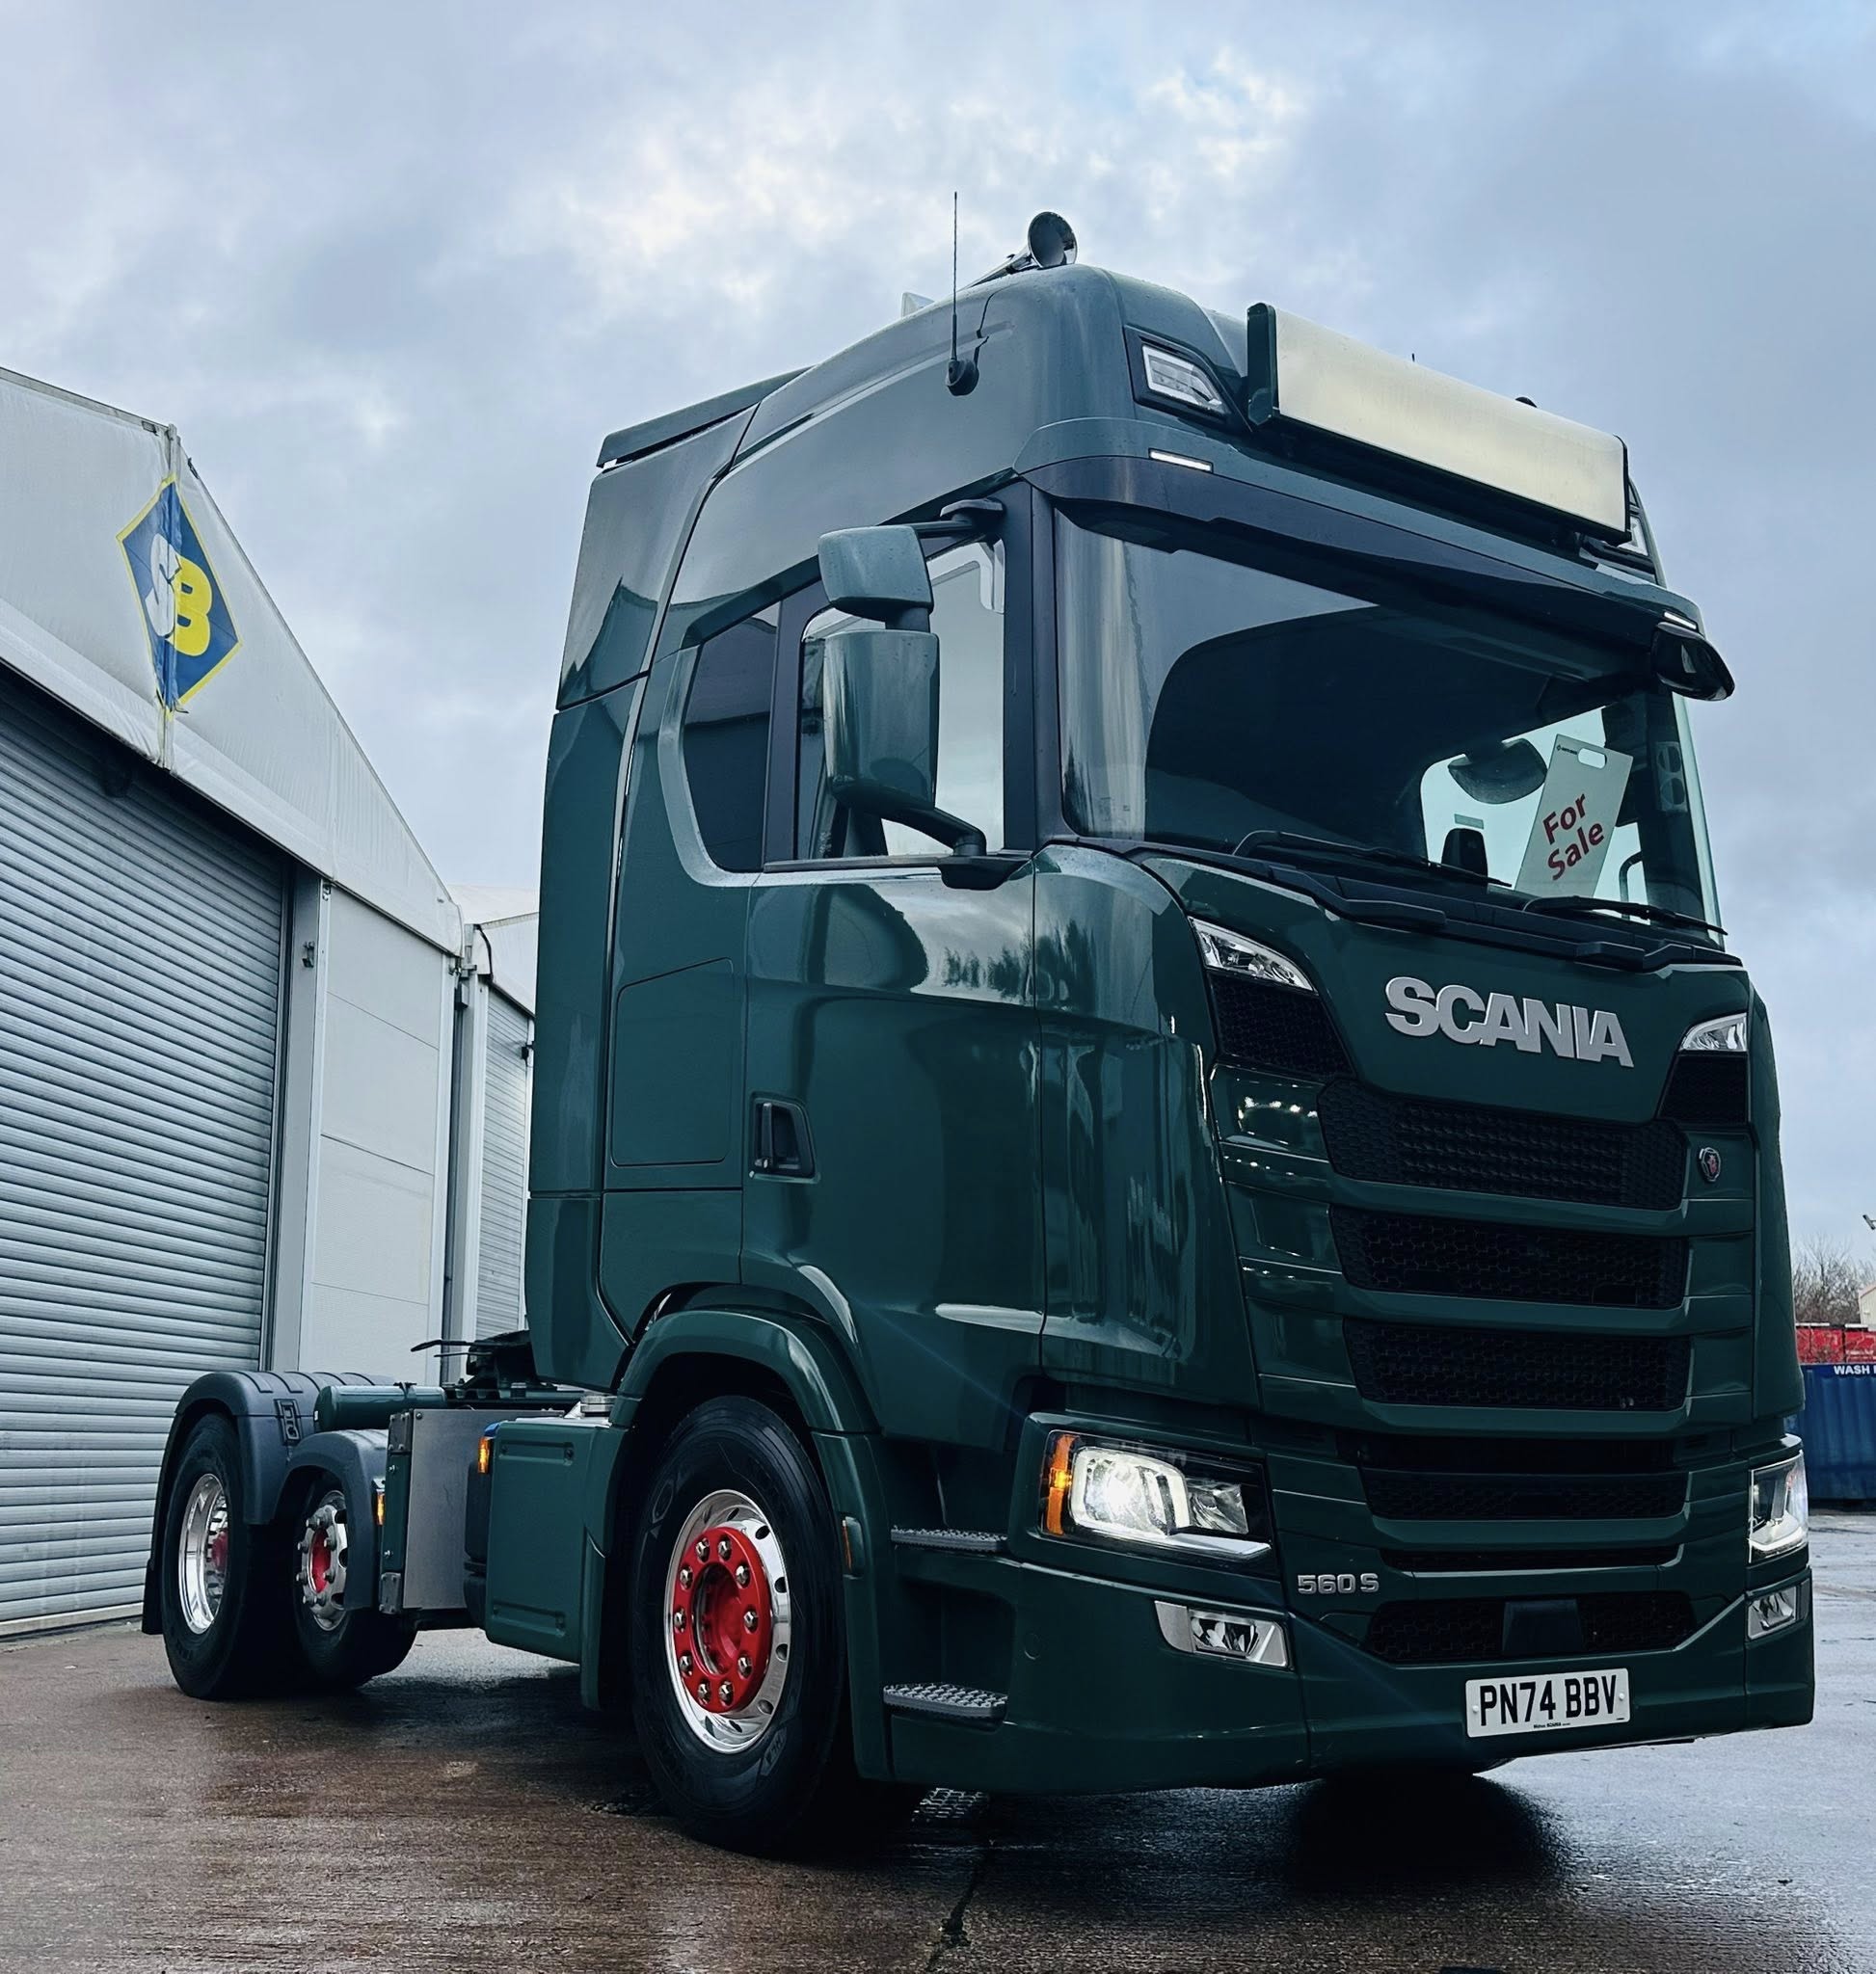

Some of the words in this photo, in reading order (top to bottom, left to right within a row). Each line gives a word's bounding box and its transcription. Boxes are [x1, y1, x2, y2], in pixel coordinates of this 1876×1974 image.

[1542, 793, 1587, 845] For
[1547, 821, 1605, 881] Sale
[1384, 975, 1635, 1068] SCANIA
[1834, 1365, 1870, 1375] WASH
[1297, 1573, 1356, 1594] 560
[1360, 1572, 1380, 1593] S
[1479, 1680, 1556, 1726] PN74
[1565, 1674, 1617, 1719] BBV
